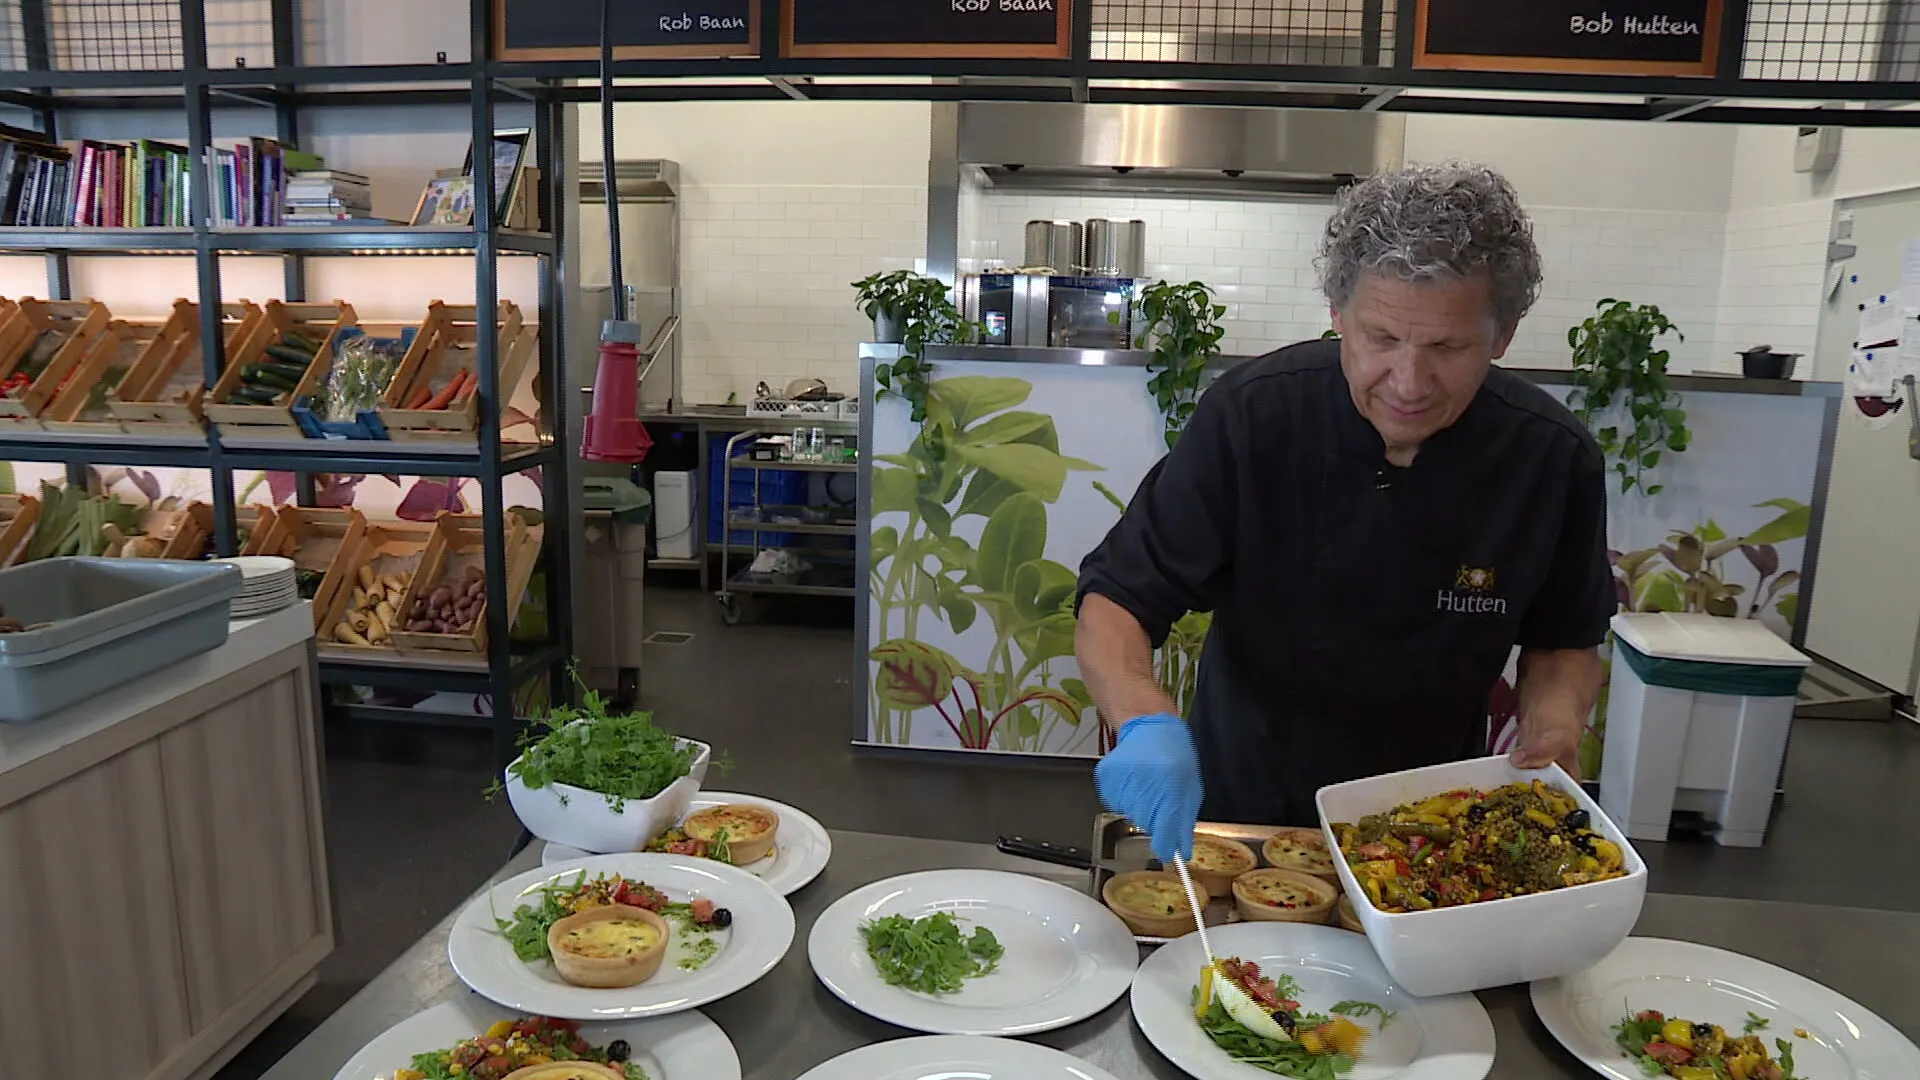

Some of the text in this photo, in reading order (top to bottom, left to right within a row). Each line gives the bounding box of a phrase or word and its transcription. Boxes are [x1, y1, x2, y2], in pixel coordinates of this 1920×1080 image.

[999, 0, 1053, 12] Baan
[659, 11, 745, 31] Rob Baan
[1570, 11, 1699, 35] Bob Hutten
[1436, 589, 1507, 615] Hutten
